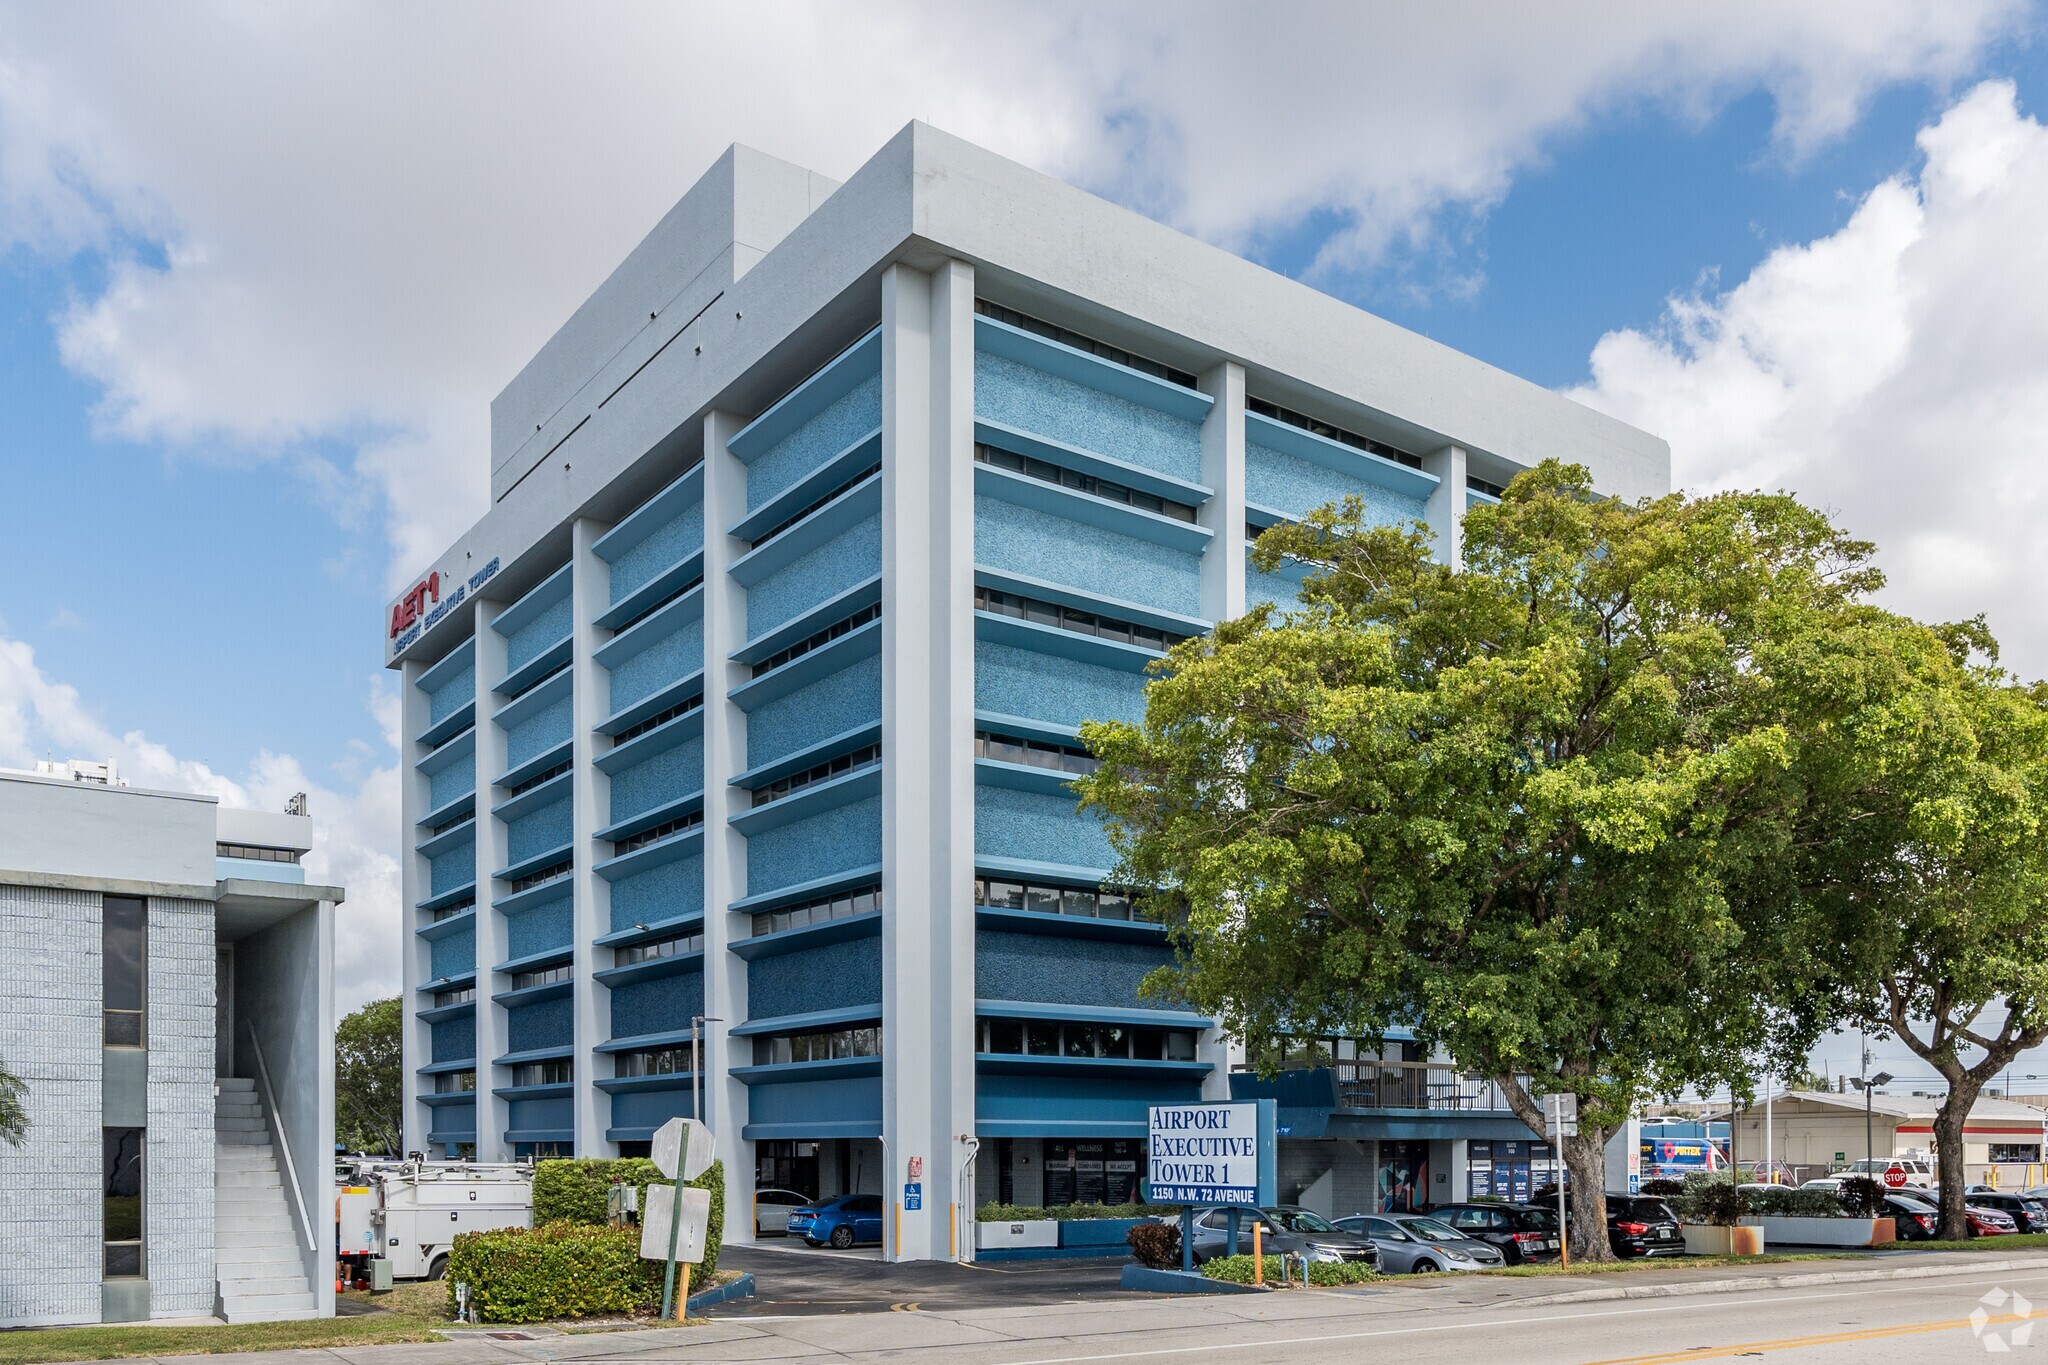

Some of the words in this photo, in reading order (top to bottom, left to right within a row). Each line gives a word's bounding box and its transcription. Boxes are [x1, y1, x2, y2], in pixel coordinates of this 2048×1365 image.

[424, 585, 465, 630] EXECUTIVE
[468, 556, 500, 592] TOWER
[1152, 1107, 1230, 1130] AIRPORT
[1055, 1144, 1065, 1152] ALL
[1076, 1144, 1103, 1152] WELLNESS
[1152, 1134, 1255, 1157] EXECUTIVE
[1674, 1147, 1701, 1156] PIRTEK
[1152, 1159, 1217, 1183] TOWER
[1222, 1163, 1230, 1184] 1
[1885, 1173, 1906, 1182] STOP
[1152, 1187, 1174, 1200] 1150
[1177, 1188, 1199, 1201] N.W.
[1201, 1188, 1213, 1202] 72
[1214, 1189, 1255, 1203] AVENUE
